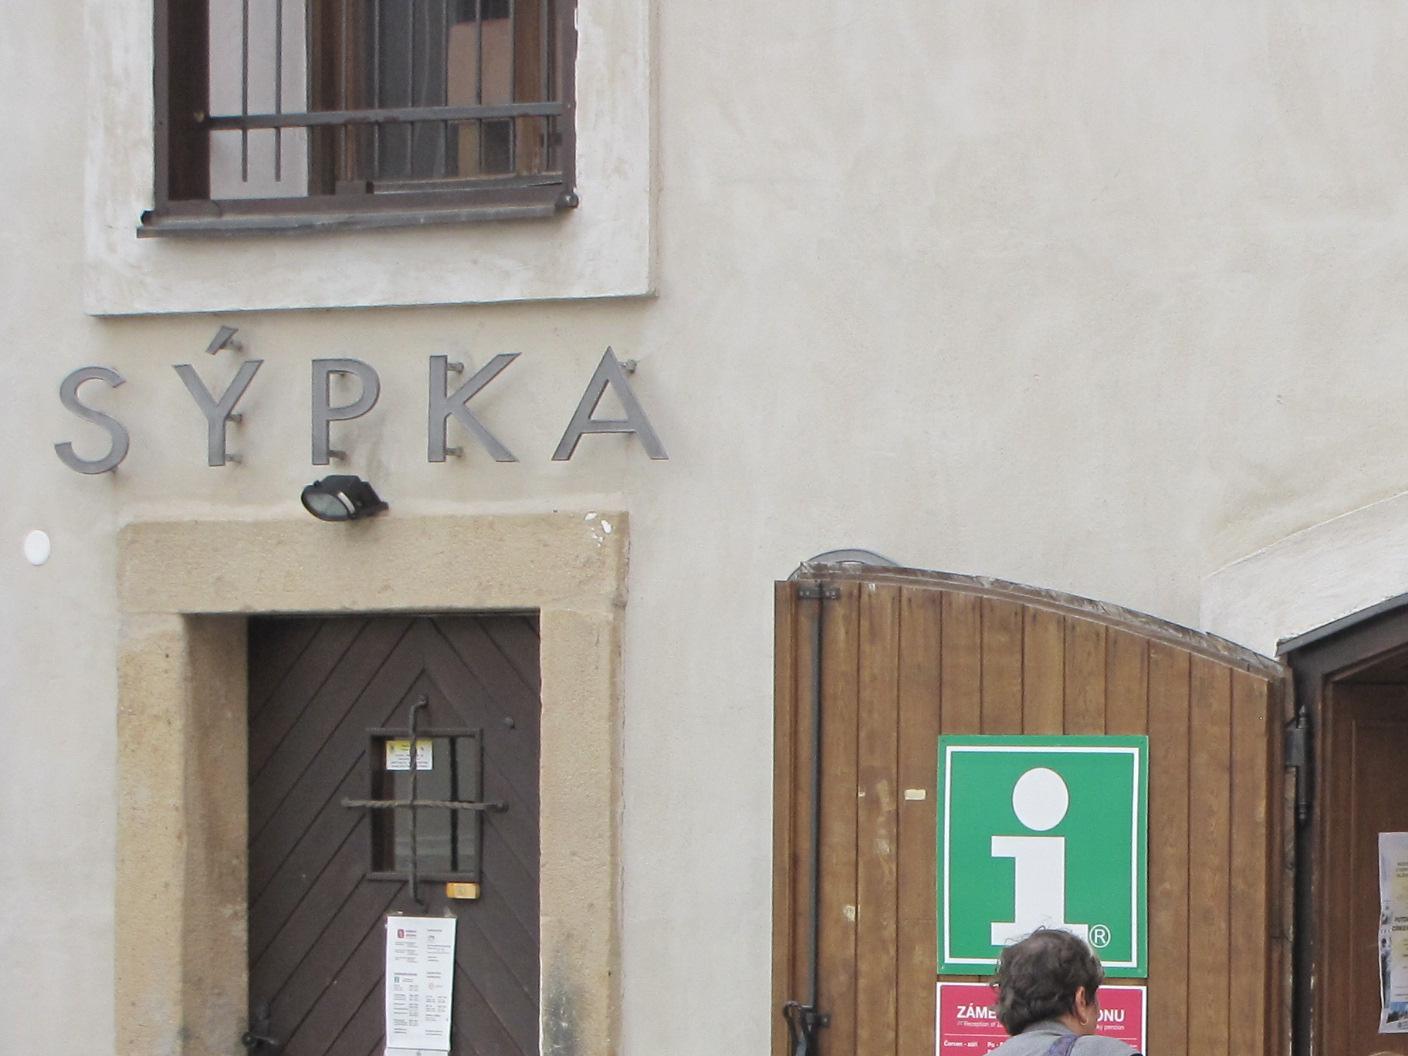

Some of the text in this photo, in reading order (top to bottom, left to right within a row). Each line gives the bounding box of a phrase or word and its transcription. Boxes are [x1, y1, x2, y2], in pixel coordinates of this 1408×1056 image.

[54, 325, 669, 475] SÝPKA
[957, 1003, 1125, 1022] ZÁME ONU
